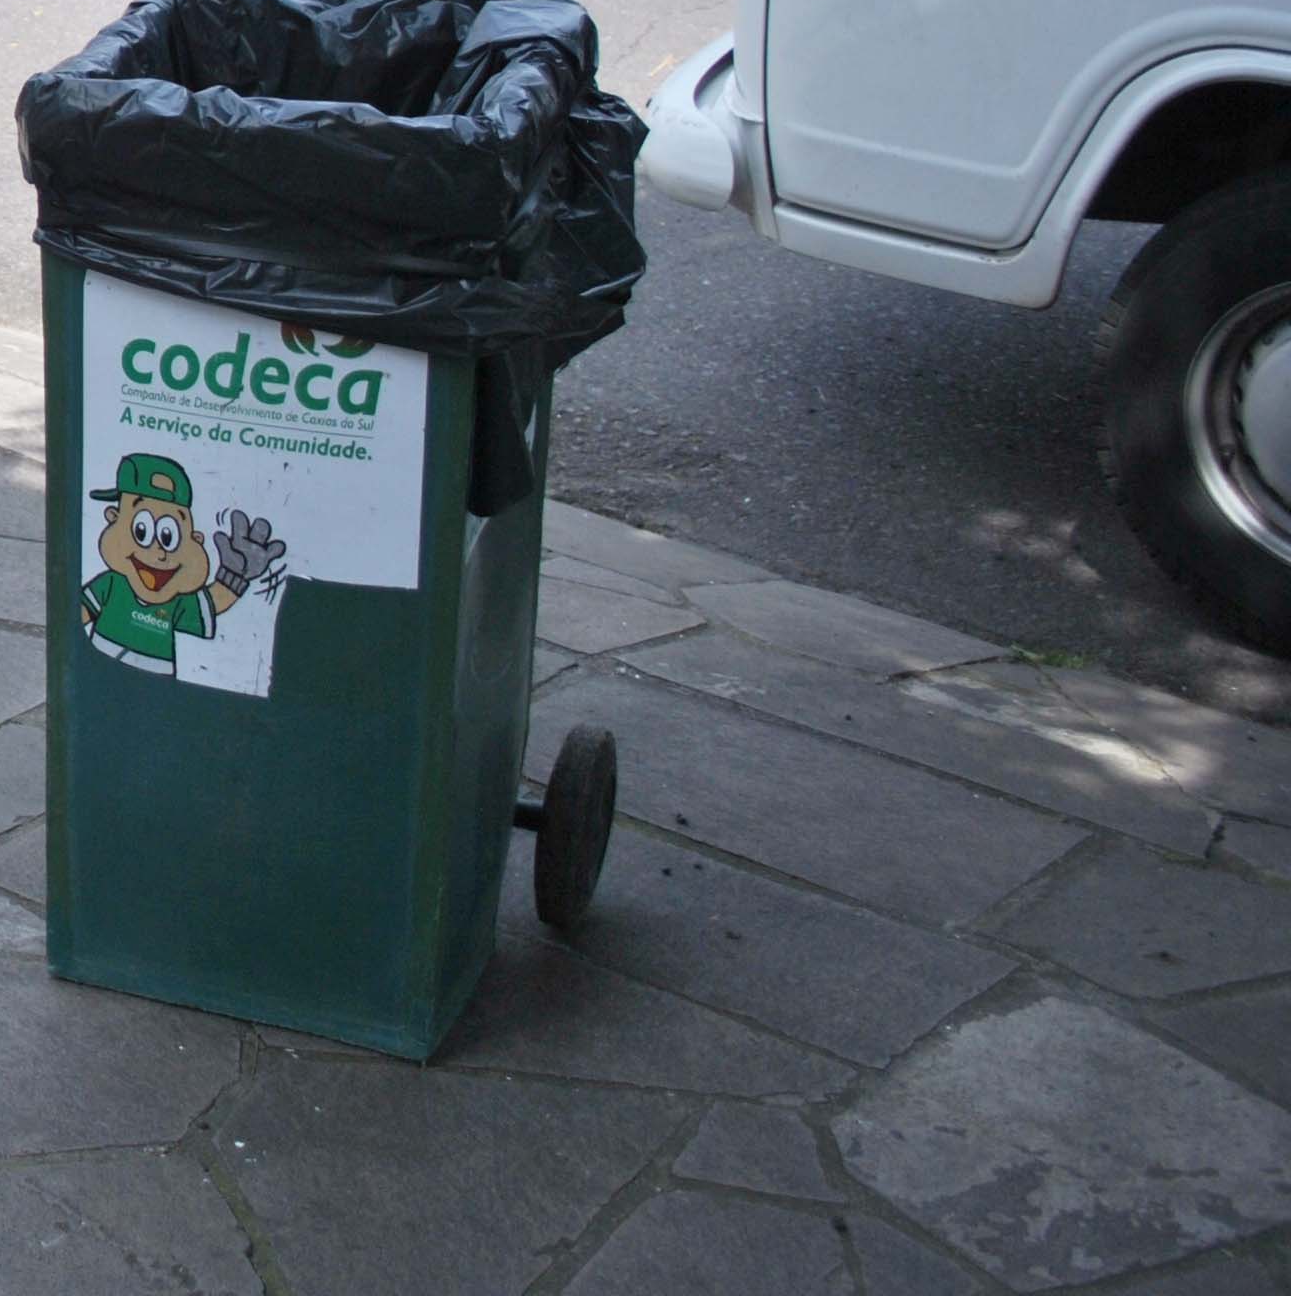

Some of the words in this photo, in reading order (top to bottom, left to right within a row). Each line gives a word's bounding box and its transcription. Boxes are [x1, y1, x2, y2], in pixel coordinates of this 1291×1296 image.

[121, 331, 383, 416] codeca
[120, 406, 133, 425] A
[137, 413, 203, 441] serviço
[208, 423, 232, 443] da
[239, 427, 373, 461] Comunidade.
[121, 383, 176, 404] Companhia
[179, 393, 191, 408] de
[285, 410, 299, 423] de
[301, 412, 338, 428] Caxias
[357, 418, 375, 432] Sul
[132, 610, 169, 630] codeca
